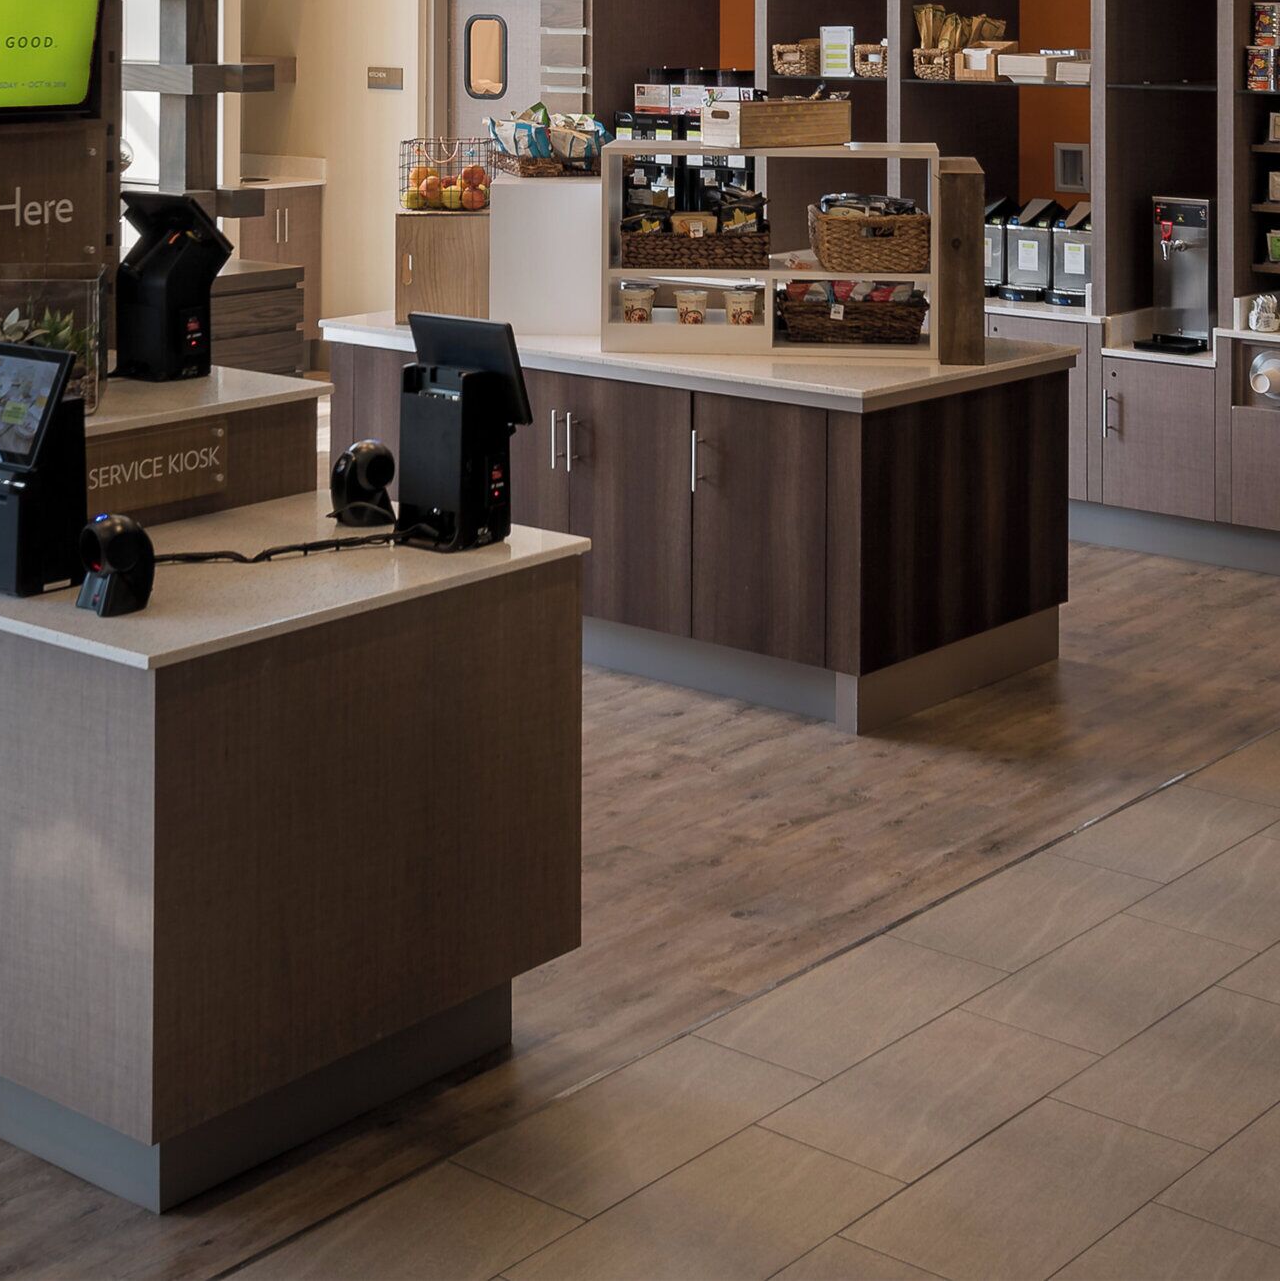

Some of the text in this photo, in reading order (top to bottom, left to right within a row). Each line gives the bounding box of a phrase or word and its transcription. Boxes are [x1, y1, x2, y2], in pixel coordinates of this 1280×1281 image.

[5, 35, 58, 49] GOOD.
[87, 445, 220, 491] SERVICE KIOSK
